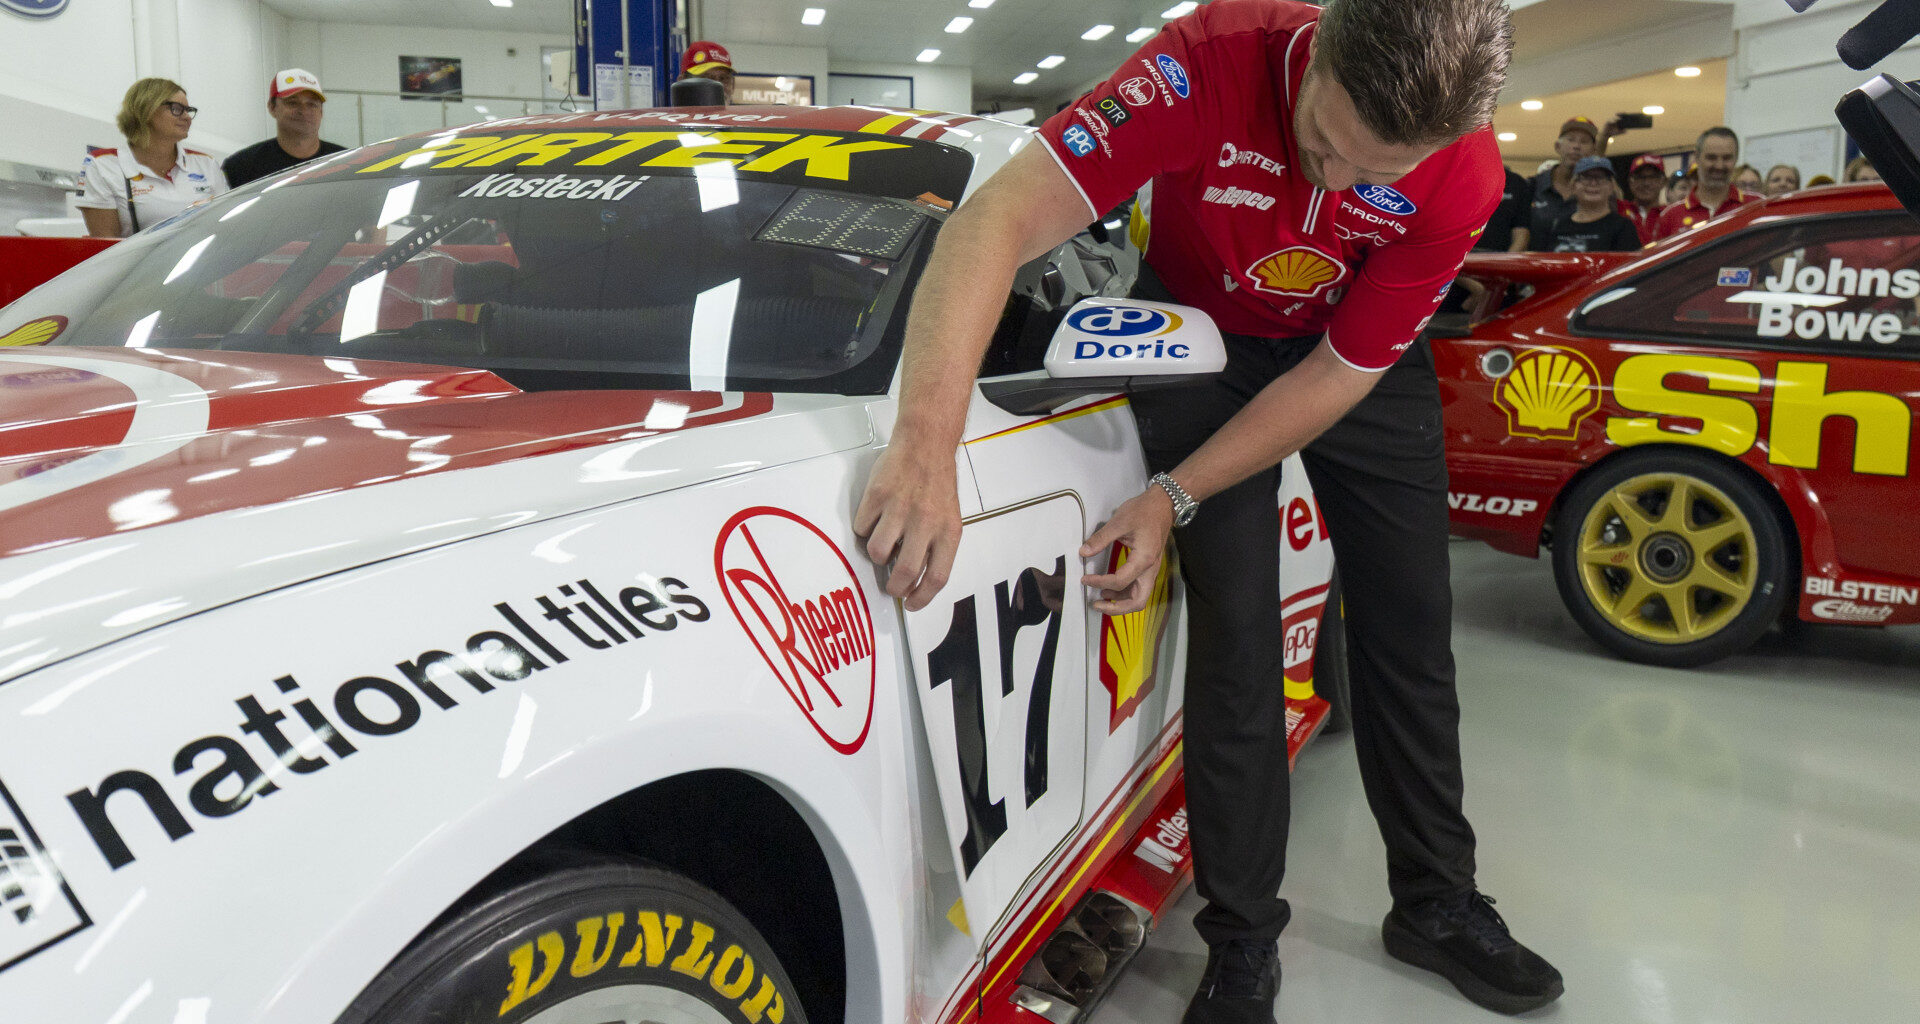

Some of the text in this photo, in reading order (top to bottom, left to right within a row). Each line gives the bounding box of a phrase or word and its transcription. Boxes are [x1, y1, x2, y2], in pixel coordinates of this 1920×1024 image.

[1141, 58, 1174, 107] RACING
[1100, 99, 1126, 124] OTR
[354, 131, 913, 182] PIRTEK
[458, 173, 651, 201] Kostecki
[1214, 186, 1276, 211] Repco
[1341, 201, 1407, 235] RACING
[1765, 257, 1920, 299] Johns
[1757, 302, 1902, 344] Bowe
[1074, 339, 1191, 360] Doric
[1606, 353, 1911, 477] Sh
[1448, 491, 1538, 517] NLOP
[1805, 576, 1919, 606] BILSTEIN
[724, 522, 872, 712] Rheem
[1284, 624, 1315, 662] PPG
[65, 576, 711, 872] national tiles
[928, 553, 1067, 882] 17
[498, 910, 785, 1024] DUNLOP
